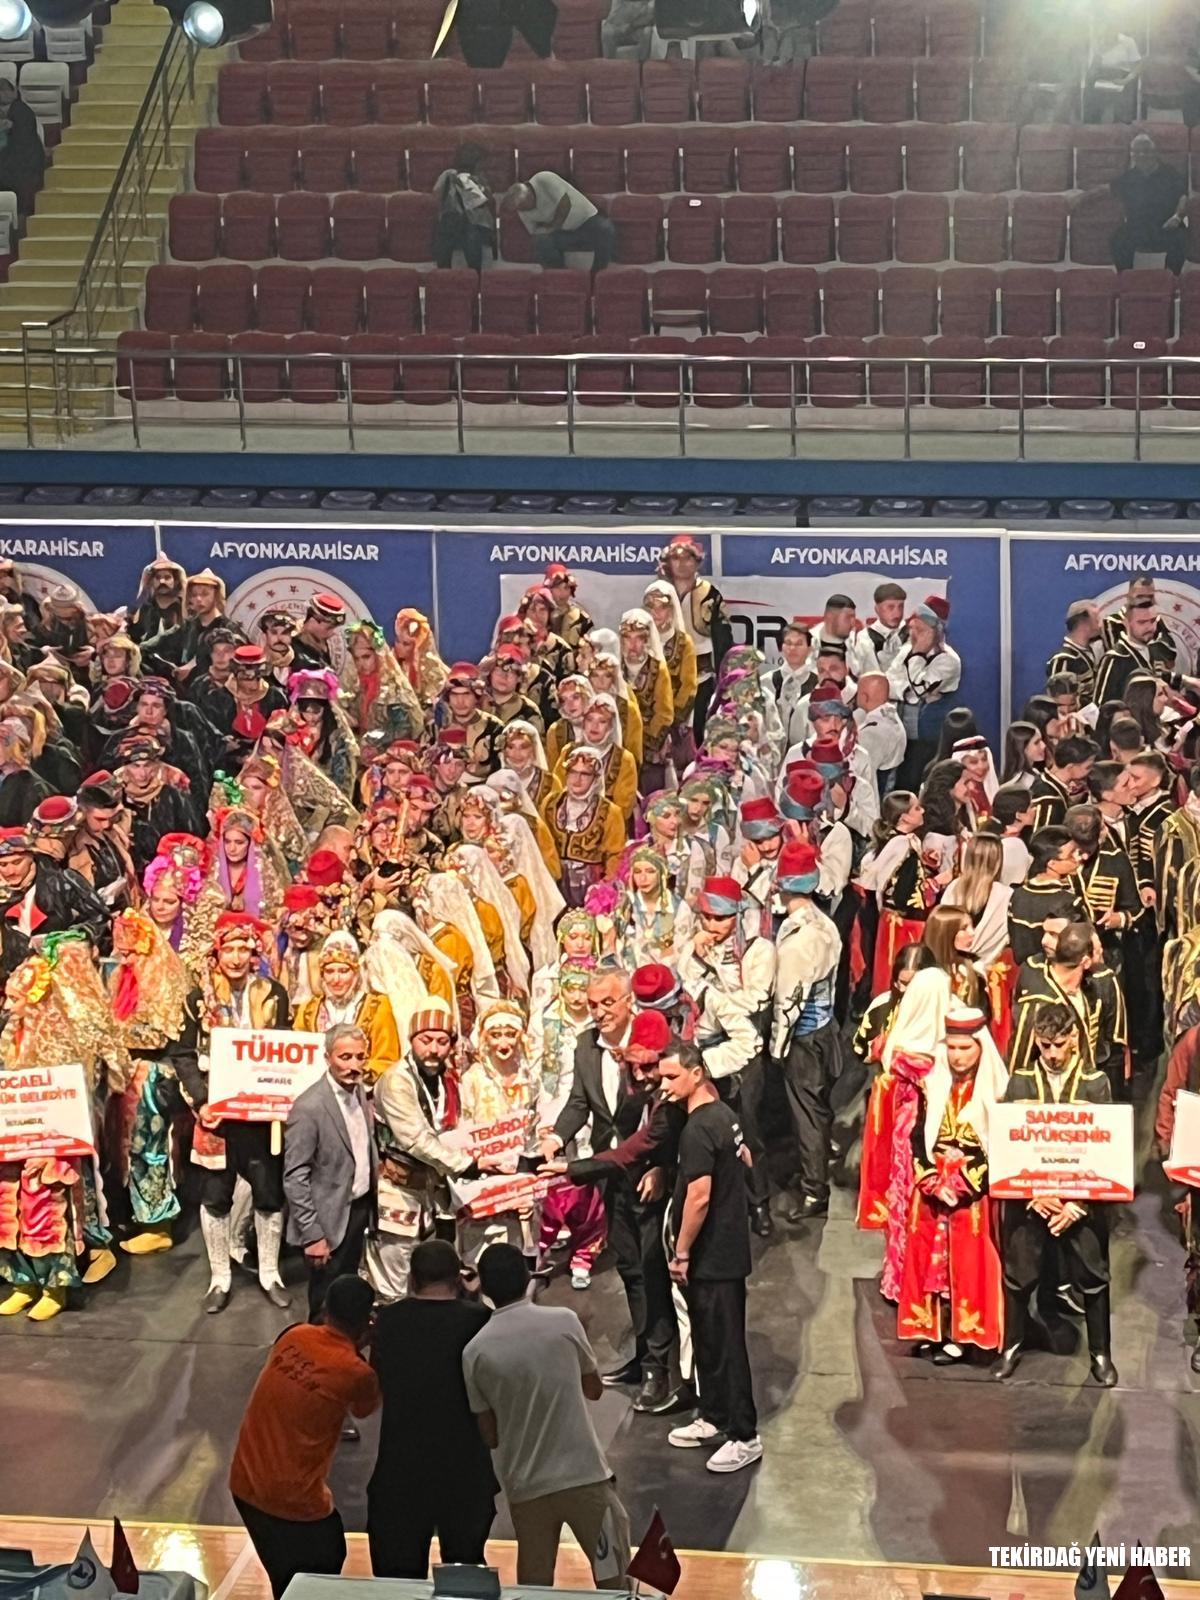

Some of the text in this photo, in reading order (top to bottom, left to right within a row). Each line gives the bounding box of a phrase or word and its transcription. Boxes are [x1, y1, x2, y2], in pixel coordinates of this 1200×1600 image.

[209, 541, 379, 561] AFYONKARAHİSAR
[489, 543, 663, 563] AFYONKARAHİSAR
[770, 545, 948, 566] AFYONKARAHİSAR
[231, 1034, 319, 1065] TÜHOT
[1025, 1110, 1094, 1124] SAMSUN
[1009, 1125, 1111, 1145] BÜYÜKŞEHİR
